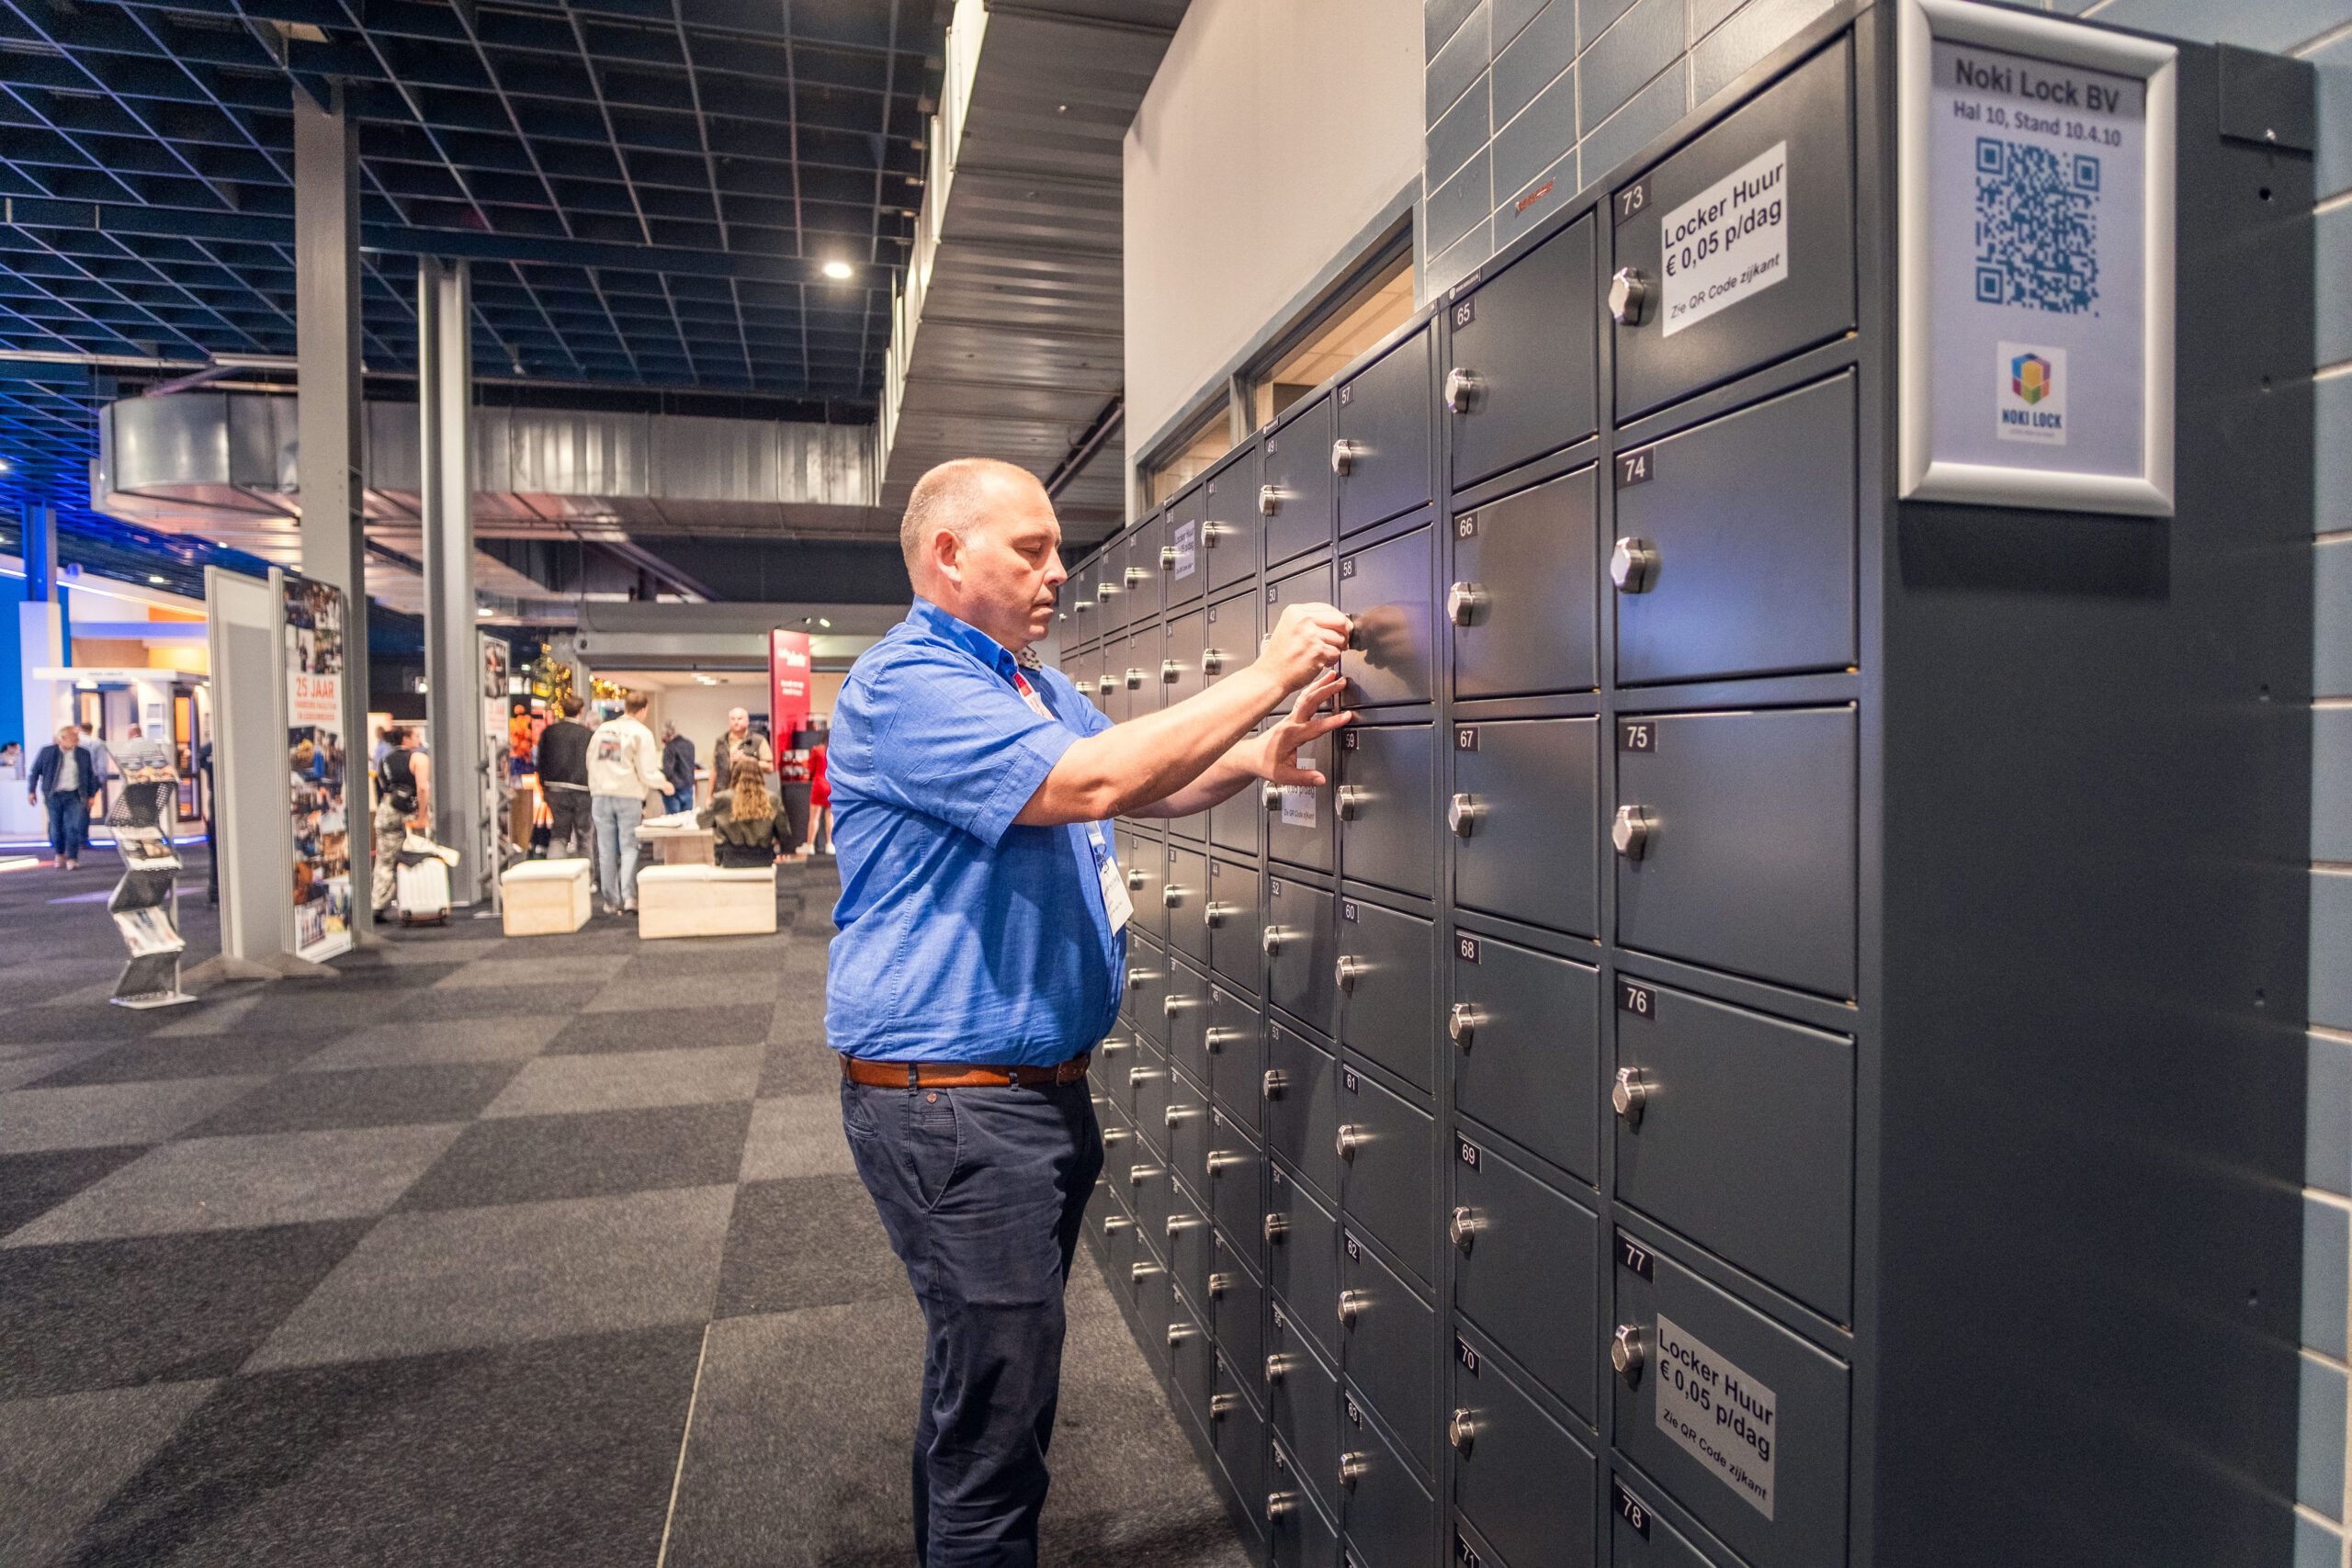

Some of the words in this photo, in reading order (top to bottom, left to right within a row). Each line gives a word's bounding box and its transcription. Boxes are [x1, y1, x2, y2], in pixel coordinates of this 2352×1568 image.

[1956, 59, 2012, 93] Noki
[2020, 70, 2079, 107] Lock
[2086, 84, 2119, 113] BV
[1953, 99, 1981, 120] Hal
[1986, 106, 2009, 129] 10,
[2015, 111, 2060, 136] Stand
[2065, 121, 2121, 147] 10.4.10
[1623, 186, 1643, 215] 73
[1665, 198, 1726, 249] Locker
[1733, 164, 1783, 208] Huur
[1666, 254, 1676, 276] €
[1682, 231, 1718, 269] 0,05
[1725, 199, 1781, 252] p/dag
[1671, 303, 1685, 319] Zie
[1690, 291, 1705, 309] QR
[1709, 276, 1736, 299] Code
[1740, 254, 1780, 284] zijkant
[1457, 302, 1470, 325] 65
[1341, 385, 1351, 404] 57
[2002, 409, 2030, 425] NOKI
[2033, 412, 2062, 429] LOCK
[1625, 456, 1645, 482] 74
[1460, 517, 1473, 536] 66
[1343, 560, 1351, 577] 58
[1269, 588, 1276, 602] 50
[296, 676, 308, 697] 25
[311, 678, 334, 699] JAAR
[1346, 733, 1354, 748] 59
[1460, 730, 1473, 748] 67
[1627, 726, 1647, 748] 75
[1272, 881, 1280, 895] 52
[1345, 904, 1354, 919] 60
[1461, 940, 1474, 959] 68
[1627, 987, 1647, 1013] 76
[1347, 1074, 1355, 1092] 61
[1462, 1144, 1476, 1165] 69
[1348, 1240, 1357, 1258] 62
[1625, 1243, 1645, 1271] 77
[1462, 1344, 1475, 1370] 70
[1660, 1328, 1719, 1387] Locker
[1725, 1374, 1773, 1426] Huur
[1660, 1359, 1670, 1382] €
[1675, 1369, 1711, 1411] 0,05
[1716, 1396, 1770, 1462] p/dag
[1663, 1408, 1678, 1427] Zie
[1680, 1424, 1696, 1443] QR
[1700, 1437, 1726, 1467] Code
[1729, 1461, 1767, 1501] zijkant
[1623, 1494, 1642, 1529] 78
